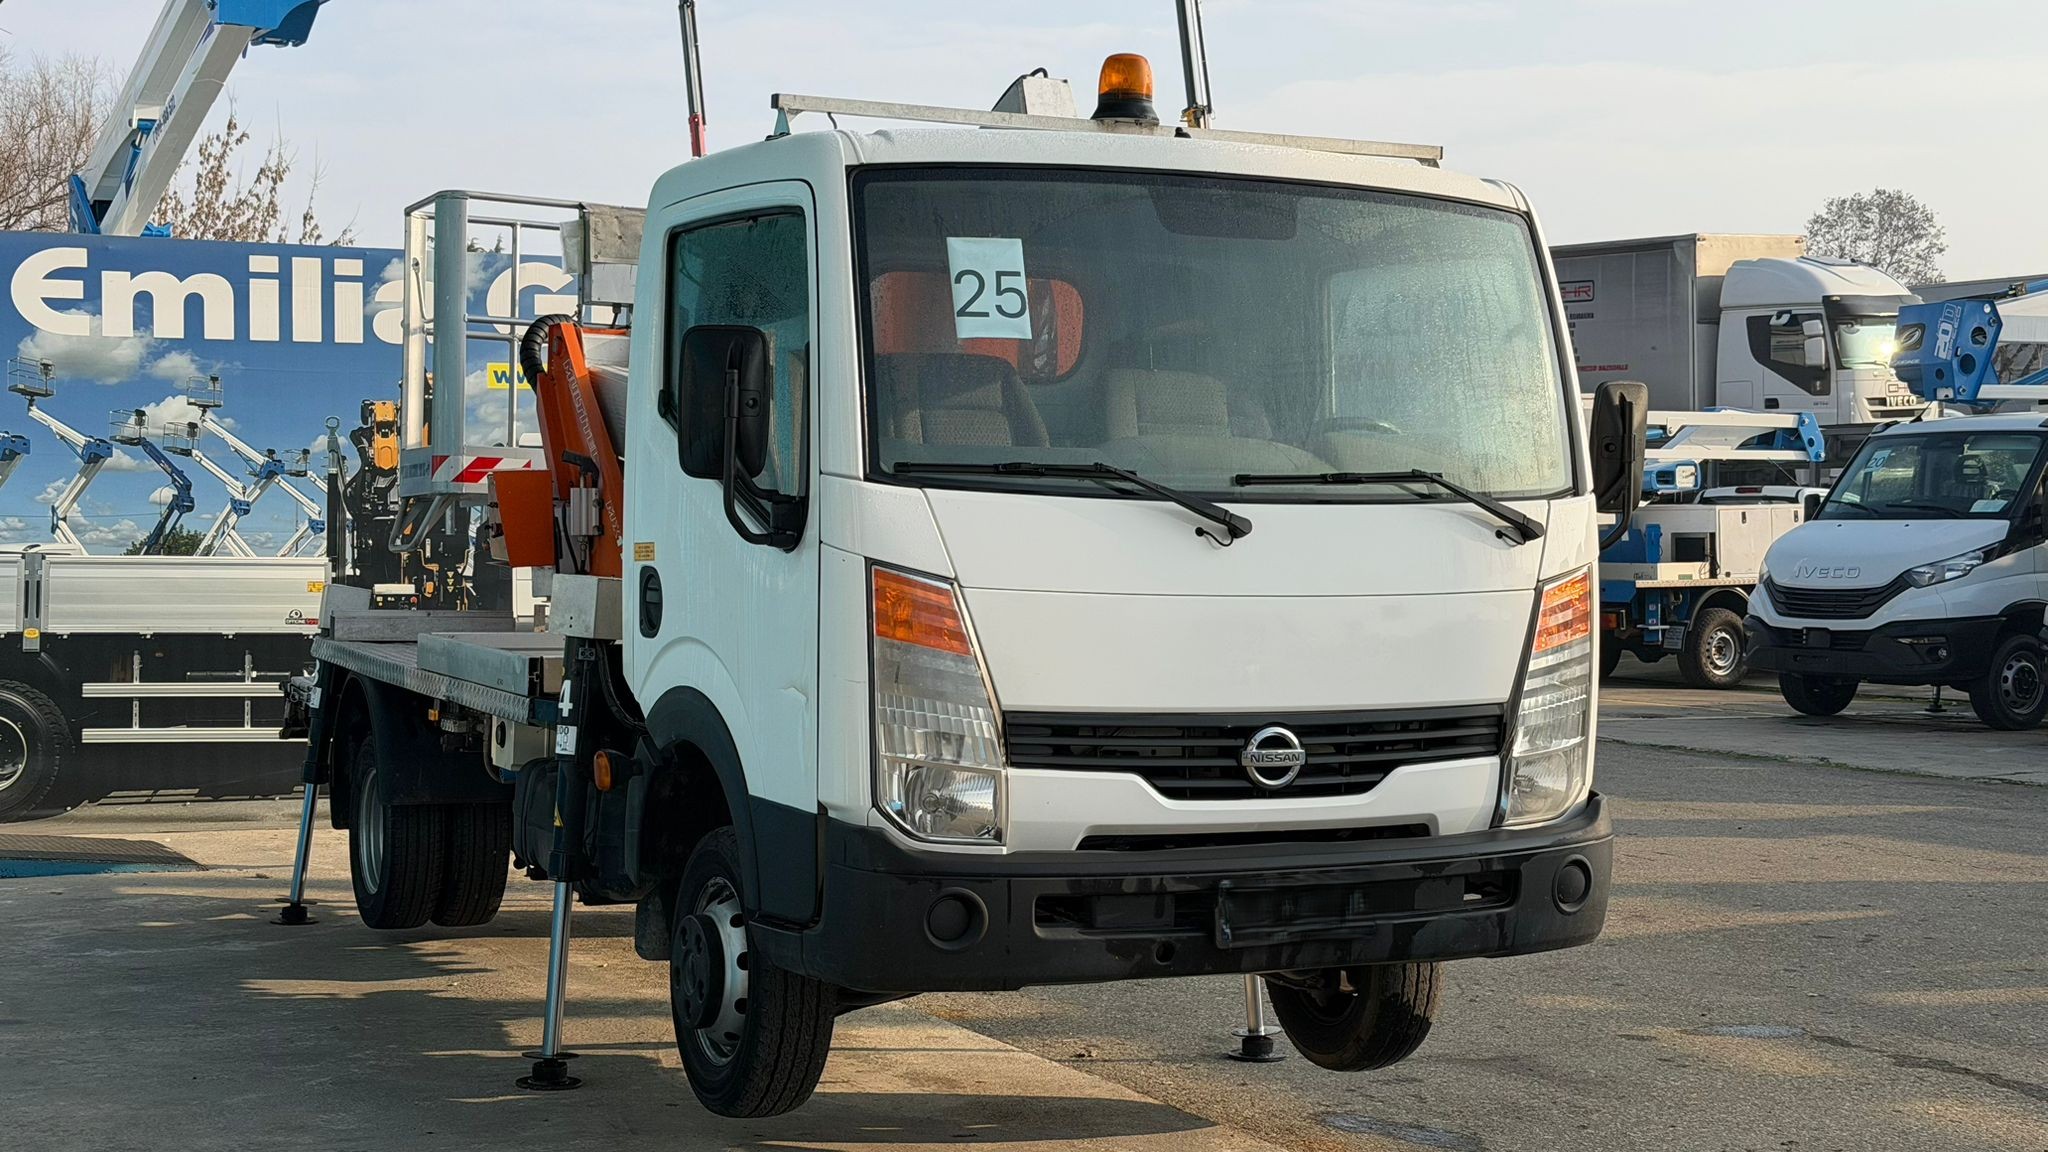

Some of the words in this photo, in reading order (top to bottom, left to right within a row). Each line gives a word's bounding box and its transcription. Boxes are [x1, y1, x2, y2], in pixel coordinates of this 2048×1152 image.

[954, 269, 1027, 319] 25
[1886, 396, 1917, 408] IVECO
[1869, 457, 1885, 467] 20
[1795, 566, 1861, 579] IVECO
[558, 680, 573, 718] 4
[1251, 753, 1300, 763] NISSAN
